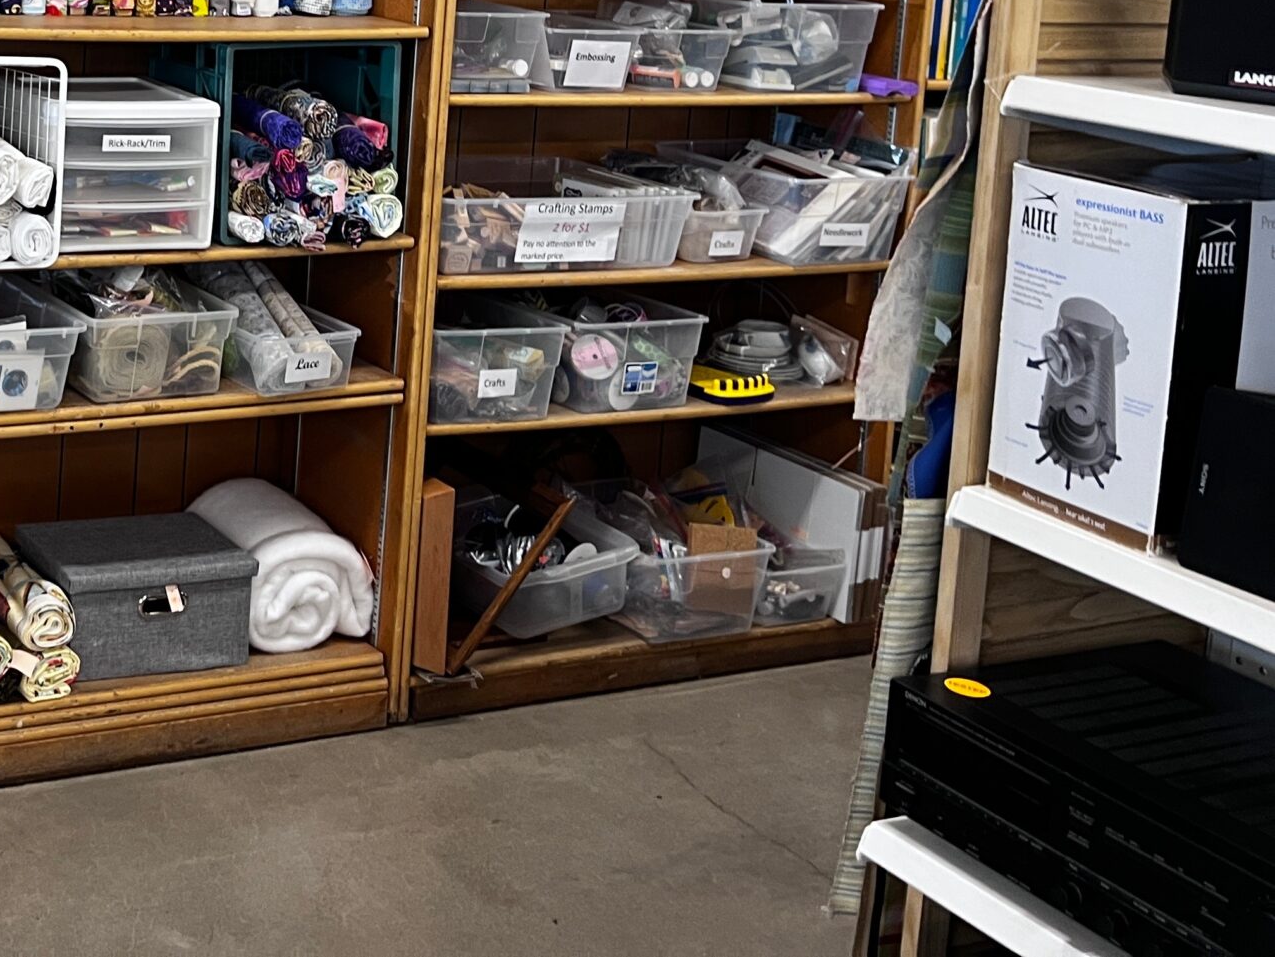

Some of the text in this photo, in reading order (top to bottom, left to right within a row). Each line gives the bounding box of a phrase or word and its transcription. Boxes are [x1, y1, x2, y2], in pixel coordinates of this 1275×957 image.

[575, 52, 615, 63] Embossing
[1233, 70, 1275, 87] LANC
[539, 202, 613, 215] Crafting Stamps
[1076, 198, 1164, 224] expressionist BASS
[1021, 206, 1059, 236] ALTEC
[553, 222, 590, 234] 2 for $1
[1197, 242, 1236, 268] ALTEC
[295, 358, 319, 370] Lace
[484, 378, 505, 388] Crafts
